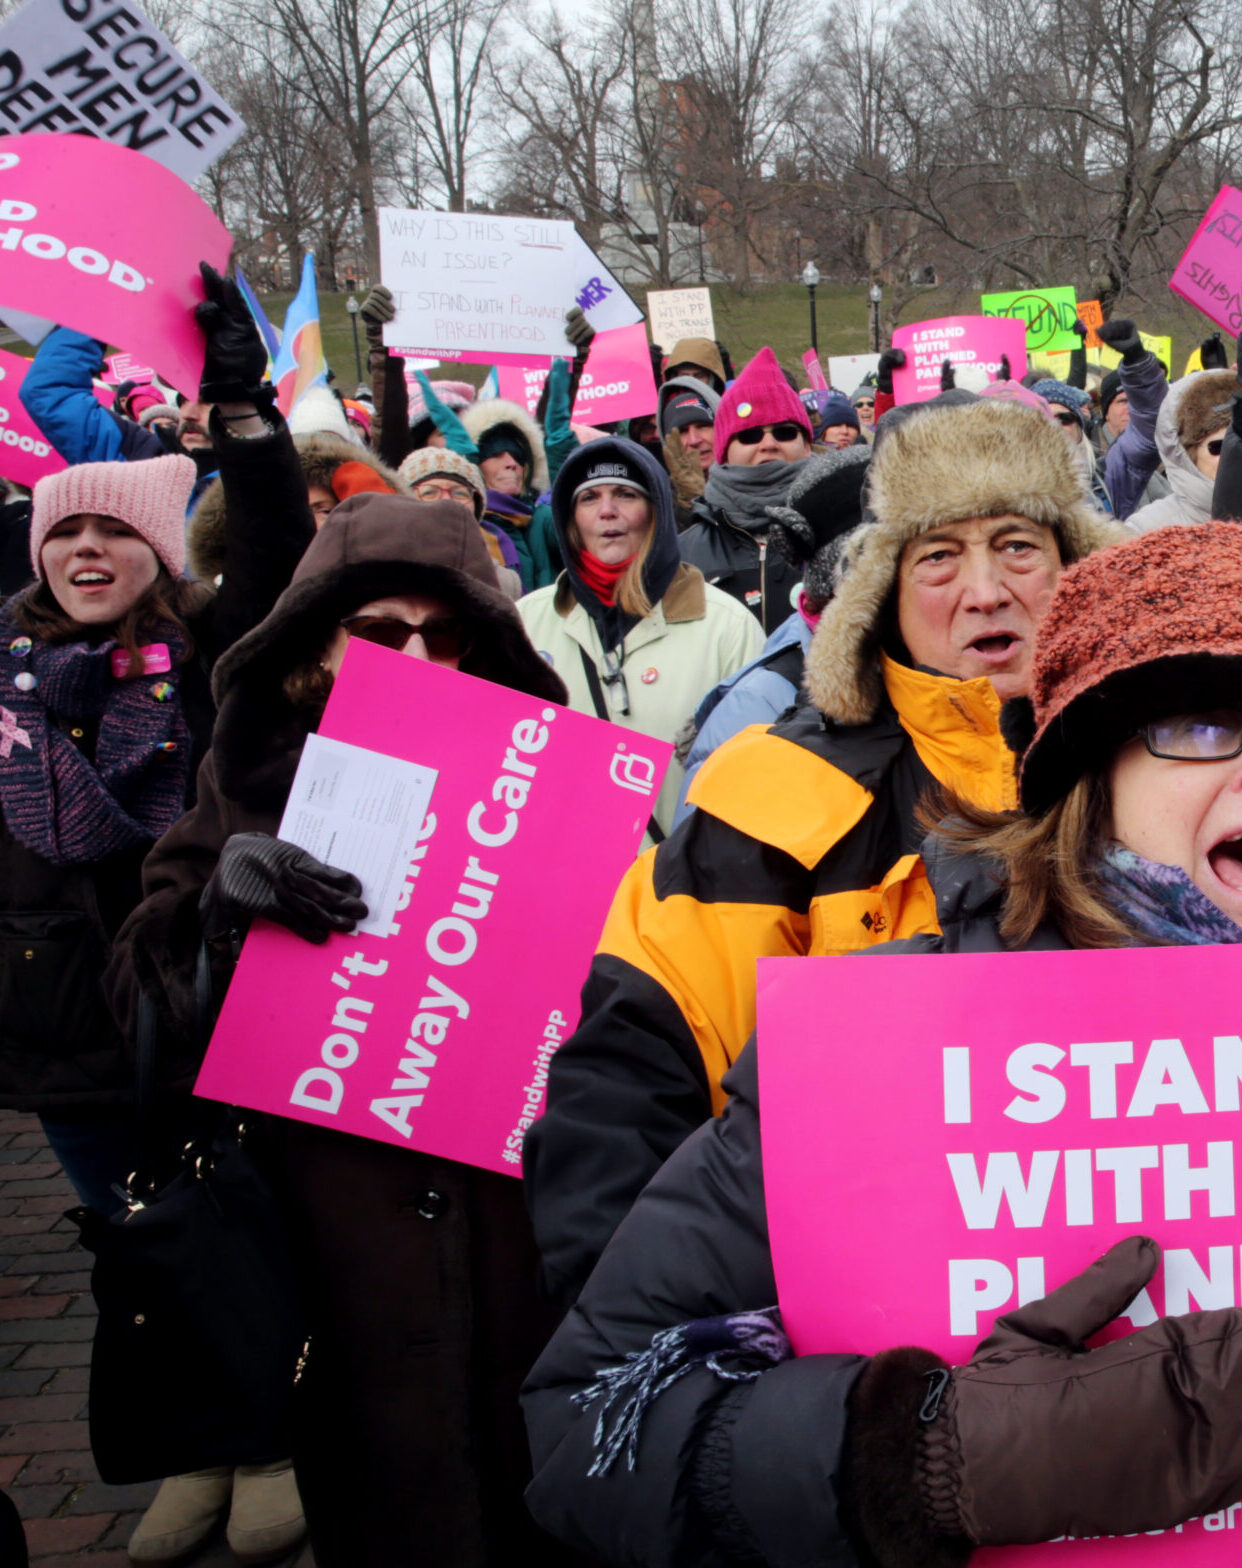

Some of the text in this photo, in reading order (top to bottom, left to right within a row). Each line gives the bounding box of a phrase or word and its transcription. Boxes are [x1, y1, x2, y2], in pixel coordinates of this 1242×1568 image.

[0, 48, 100, 138] DEF
[44, 46, 169, 150] MEN
[62, 0, 231, 149] SECURE
[386, 214, 567, 246] WHY IS THIS STILL
[400, 250, 514, 270] AN ISSUE?
[393, 290, 409, 312] I
[416, 291, 472, 313] STAND
[474, 297, 503, 315] WITH
[432, 318, 547, 342] PARENTHOOD
[912, 326, 966, 342] I STAND
[914, 340, 950, 354] WITH
[368, 975, 471, 1138] Away
[425, 856, 501, 967] Our
[466, 707, 558, 848] Care.
[288, 951, 390, 1115] Don't
[942, 1047, 972, 1124] I
[945, 1140, 1237, 1230] WITH
